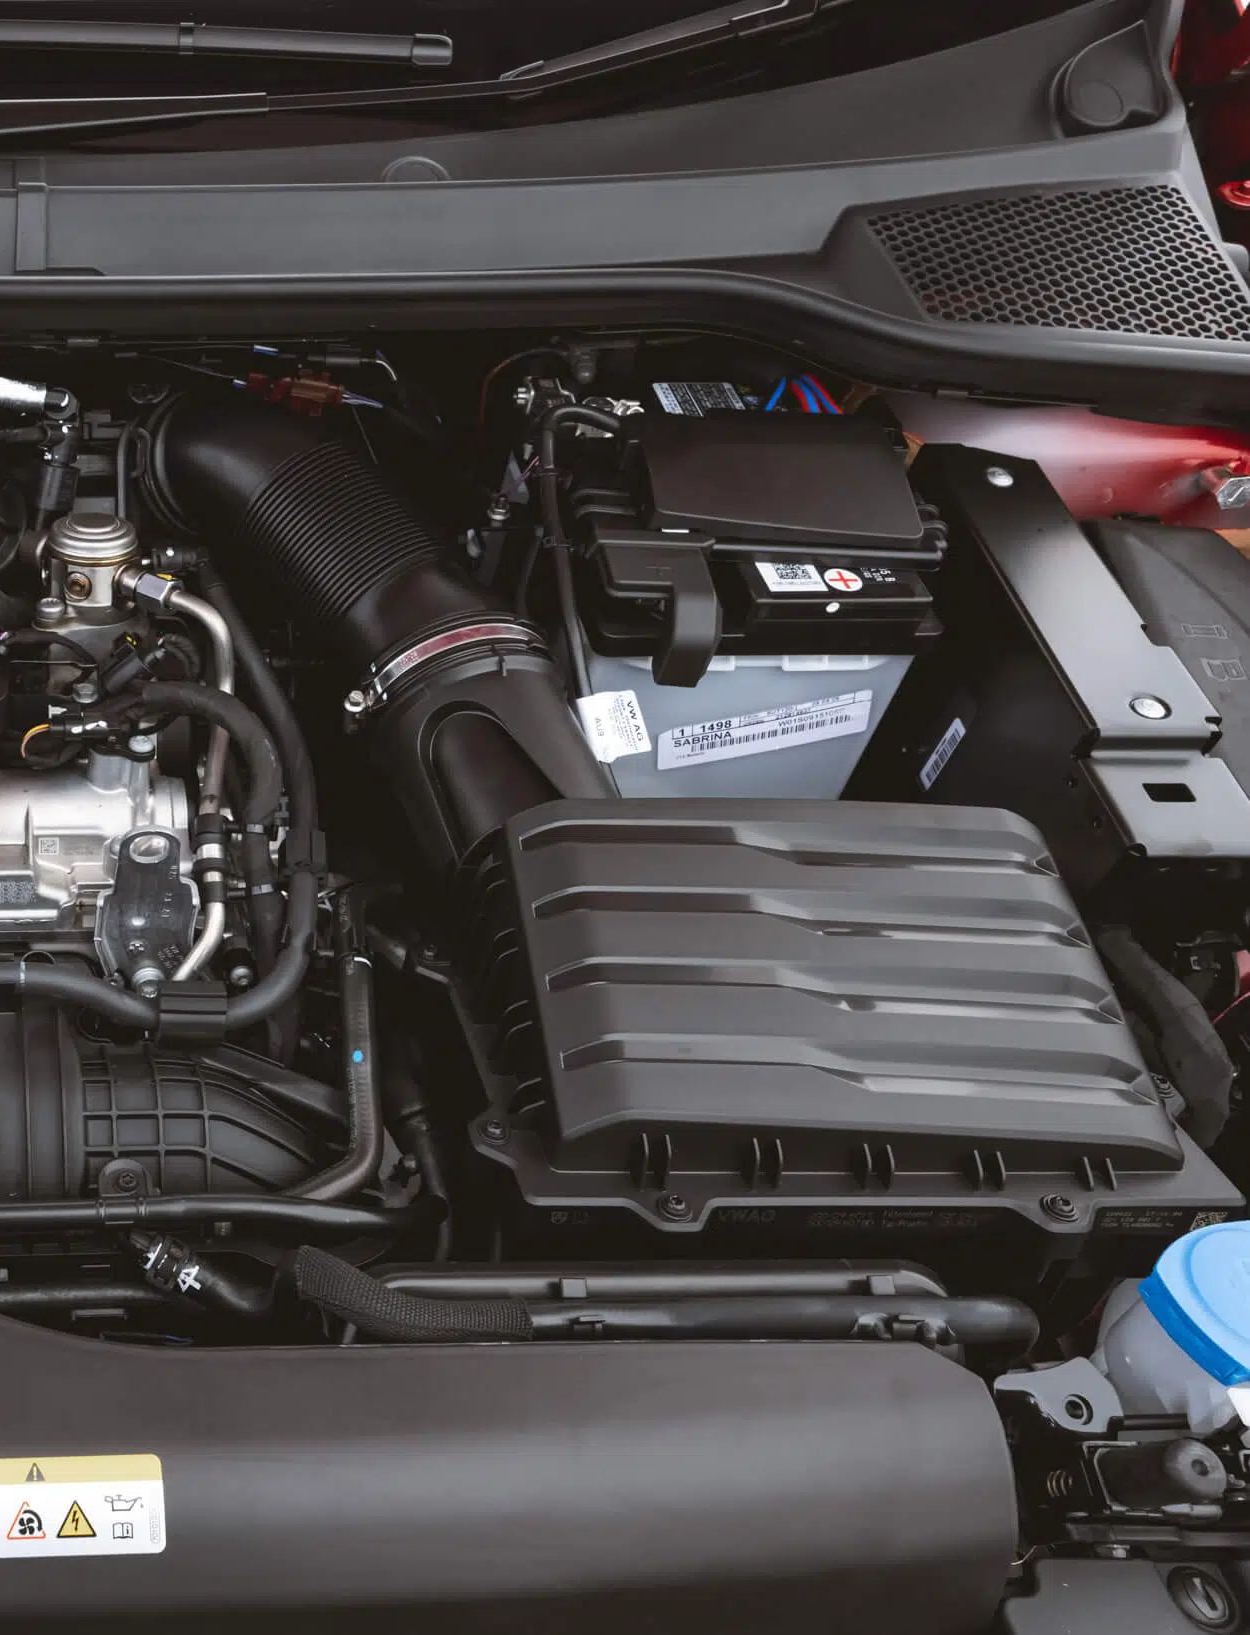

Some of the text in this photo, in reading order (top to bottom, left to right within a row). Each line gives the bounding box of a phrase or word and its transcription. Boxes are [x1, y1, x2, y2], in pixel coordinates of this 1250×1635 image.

[627, 700, 644, 741] VW AG
[678, 720, 732, 737] 1 1498
[673, 731, 732, 748] SABRINA
